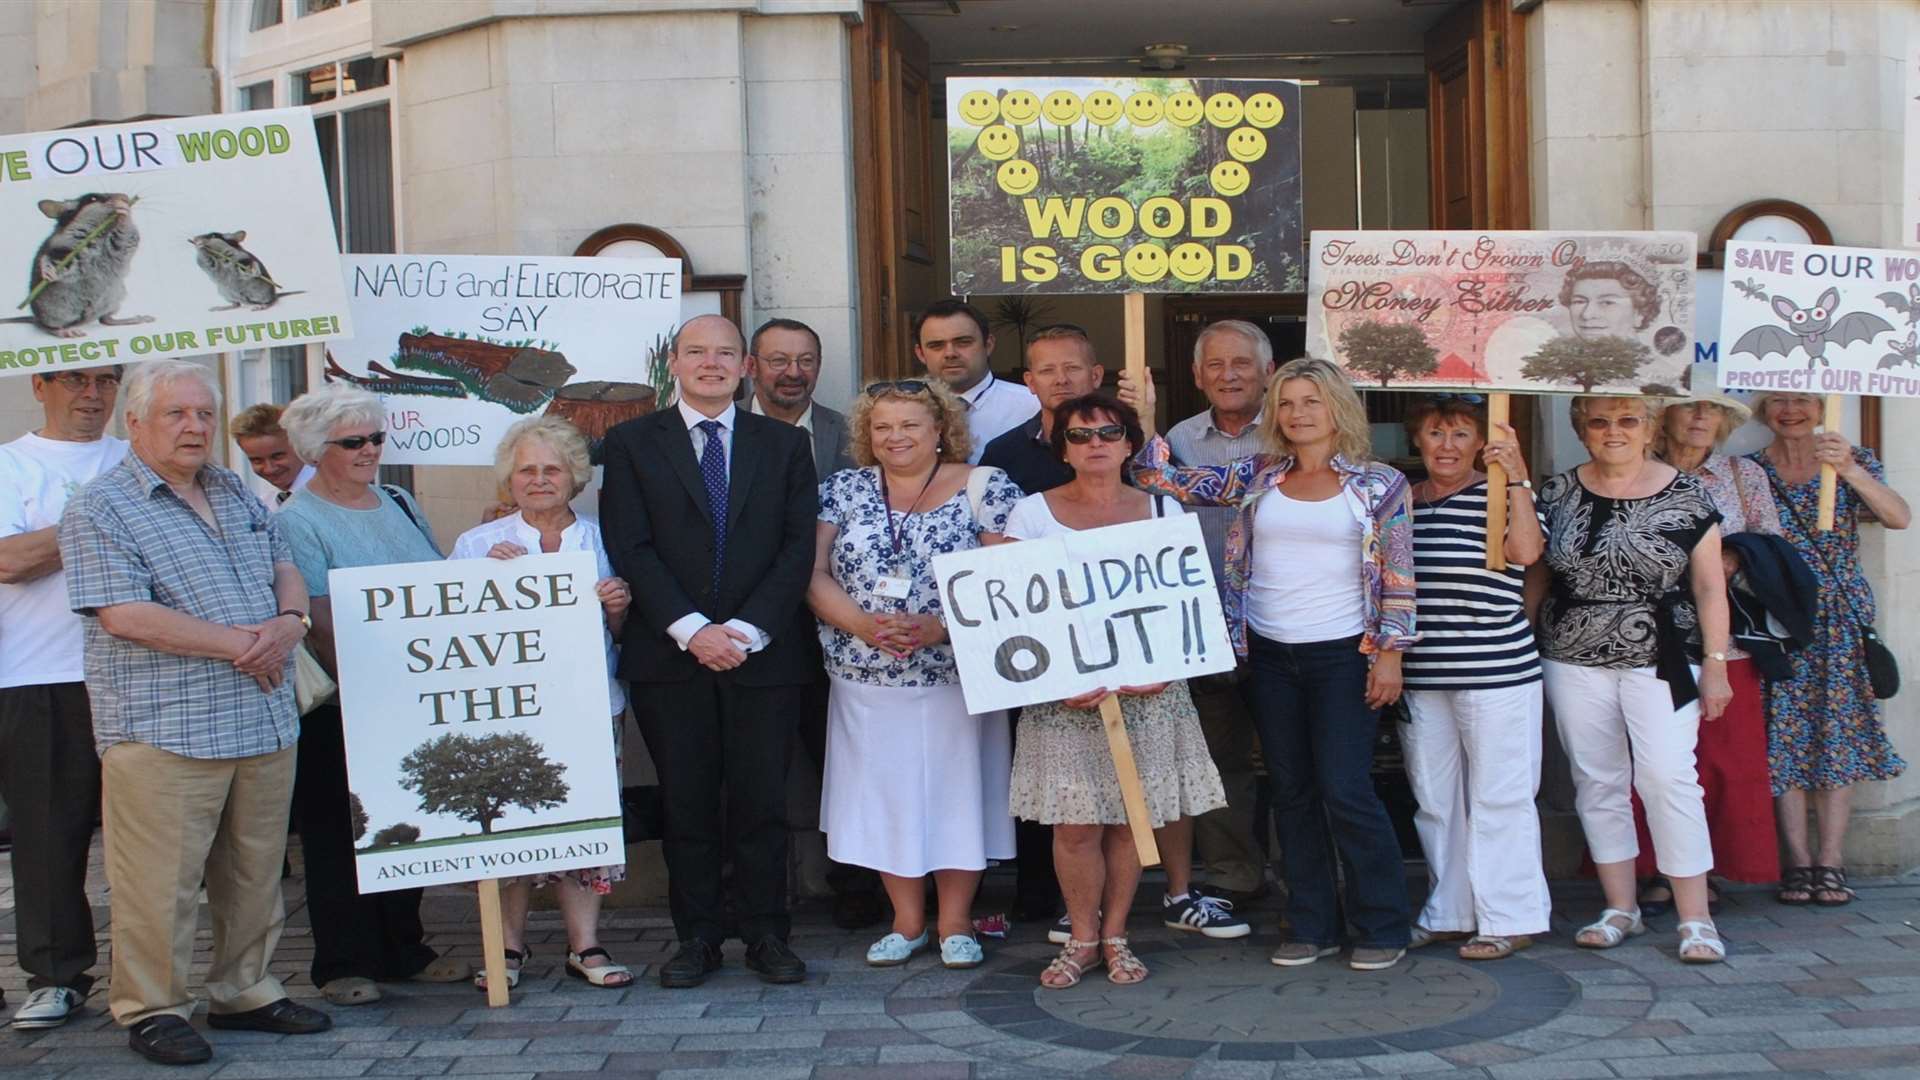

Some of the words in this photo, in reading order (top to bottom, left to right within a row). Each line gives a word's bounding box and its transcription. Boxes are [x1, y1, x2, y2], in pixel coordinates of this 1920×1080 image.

[0, 151, 32, 181] E
[45, 132, 164, 175] OUR
[176, 124, 291, 163] WOOD
[1022, 196, 1232, 239] WOOD
[1000, 245, 1060, 283] IS
[1080, 242, 1252, 283] GOOD
[1321, 239, 1380, 267] Trees
[1386, 239, 1461, 267] Don't
[1462, 235, 1545, 270] Grown
[1551, 239, 1586, 268] On
[1734, 248, 1795, 275] SAVE
[1804, 253, 1874, 279] OUR
[1885, 257, 1920, 281] WO
[354, 261, 447, 298] NAGG
[456, 265, 511, 298] and
[1322, 280, 1441, 322] Money
[1450, 279, 1554, 313] Either
[480, 305, 548, 332] SAY
[0, 339, 119, 369] ROTECT
[130, 331, 198, 355] OUR
[206, 316, 340, 346] FUTURE!
[1726, 369, 1817, 389] PROTECT
[1821, 369, 1862, 392] OUR
[391, 424, 482, 451] WOODS
[361, 573, 578, 622] PLEASE
[947, 546, 1206, 627] CROUDACE
[406, 629, 546, 673] SAVE
[994, 597, 1206, 682] OUT!!
[419, 683, 542, 726] THE
[376, 855, 475, 880] ANCIENT
[479, 841, 609, 869] WOODLAND
